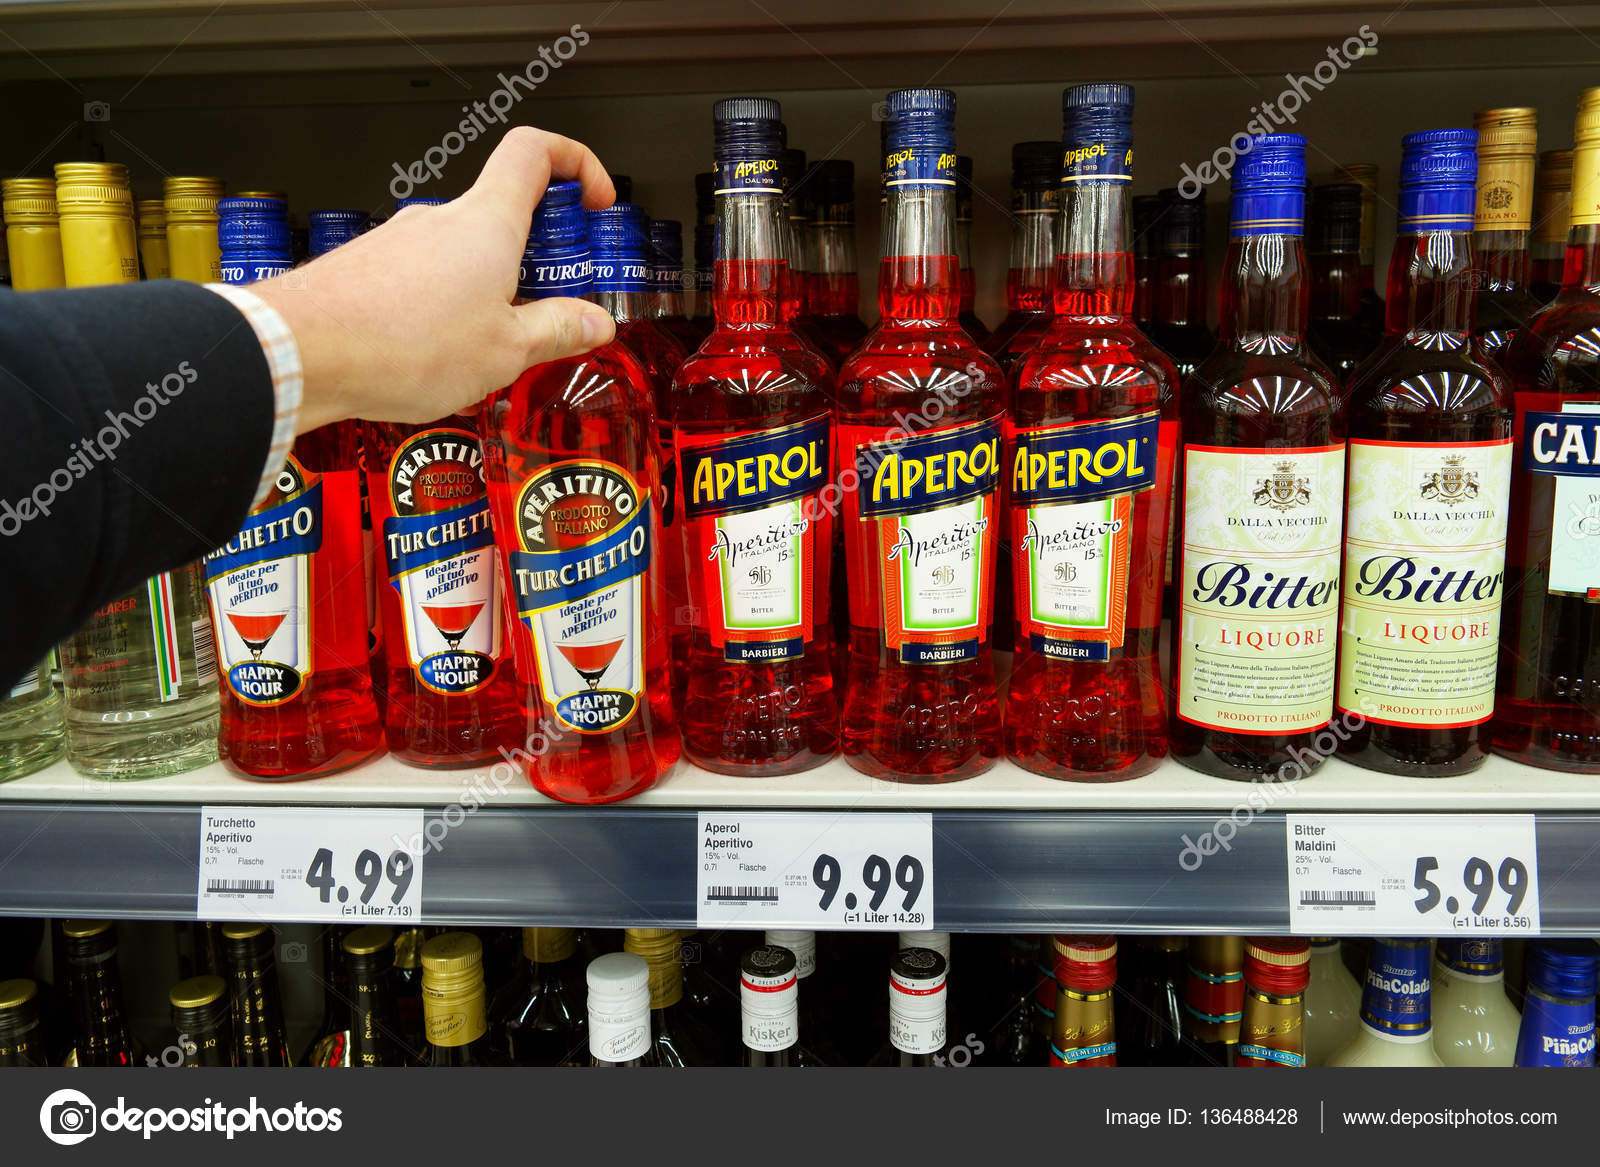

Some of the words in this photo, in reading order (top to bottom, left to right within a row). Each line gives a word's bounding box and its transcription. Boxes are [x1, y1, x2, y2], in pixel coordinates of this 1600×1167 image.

[1063, 142, 1108, 169] APEROL
[734, 159, 779, 180] APEROL
[745, 177, 761, 185] DAL
[1533, 422, 1600, 466] CA
[693, 441, 822, 505] APEROL
[872, 437, 1000, 503] APEROL
[1013, 438, 1145, 493] APEROL
[419, 471, 475, 486] PRODOTTO
[423, 483, 473, 498] ITALIANO
[525, 475, 633, 544] APERITIVO
[550, 504, 611, 521] PRODOTTO
[1393, 510, 1440, 521] DALLA
[1446, 510, 1495, 520] VECCHIA
[555, 517, 609, 535] ITALIANO
[1227, 516, 1272, 528] DALLA
[1277, 516, 1329, 528] VECCHIA
[203, 507, 313, 565] CHETTO
[709, 518, 808, 567] Aperitivo
[889, 517, 988, 567] Aperitivo
[1021, 519, 1122, 560] Aperitivo
[1047, 539, 1095, 553] ITALIANO
[425, 559, 458, 578] Ideale
[460, 553, 480, 572] per
[516, 525, 646, 596] TURCHETTO
[227, 567, 256, 586] Ideale
[258, 563, 279, 577] per
[437, 573, 447, 584] il
[447, 568, 465, 581] tuo
[1355, 555, 1504, 603] Bitter
[238, 581, 245, 593] il
[246, 577, 263, 588] tuo
[426, 572, 478, 600] APERITIVO
[1193, 561, 1338, 609] Bitter
[230, 582, 279, 608] APERITIVO
[559, 598, 597, 618] Ideale
[597, 588, 618, 609] per
[574, 612, 583, 623] il
[583, 606, 603, 621] tuo
[561, 608, 617, 640] APERITIVO
[1220, 628, 1326, 650] LIQUORE
[1384, 623, 1489, 644] LIQUORE
[741, 647, 788, 658] BARBIERI
[920, 648, 965, 660] BARBIERI
[1043, 644, 1089, 657] BARBIERI
[432, 656, 480, 671] HAPPY
[238, 667, 284, 681] HAPPY
[434, 669, 479, 685] HOUR
[241, 679, 283, 696] HOUR
[569, 693, 622, 710] HAPPY
[1379, 703, 1442, 716] PRODOTTO
[1445, 703, 1485, 716] ITALIANO
[573, 706, 620, 723] HOUR
[1217, 710, 1278, 723] PRODOTTO
[1280, 710, 1321, 723] ITALIANO
[206, 817, 256, 828] Turchetto
[705, 822, 740, 835] Aperol
[1294, 824, 1326, 836] Bitter
[206, 832, 252, 844] Aperitivo
[704, 837, 753, 850] Aperitivo
[1294, 840, 1336, 851] Maldini
[206, 846, 221, 854] 15%
[705, 852, 721, 860] 15%
[238, 857, 264, 865] Flasche
[739, 863, 767, 872] Flasche
[1295, 855, 1312, 864] 25%
[305, 847, 414, 905] 4.99
[1332, 866, 1362, 875] Flasche
[812, 853, 925, 913] 9.99
[1413, 856, 1529, 917] 5.99
[341, 904, 357, 916] (=1
[361, 905, 385, 915] Liter
[388, 905, 413, 917] 7.13)
[843, 912, 860, 924] (=1
[864, 912, 889, 923] Liter
[892, 912, 925, 924] 14.28)
[1452, 916, 1469, 929] (=1
[1474, 916, 1500, 927] Liter
[1503, 916, 1531, 929] 8.56)
[749, 1026, 791, 1043] Kisker
